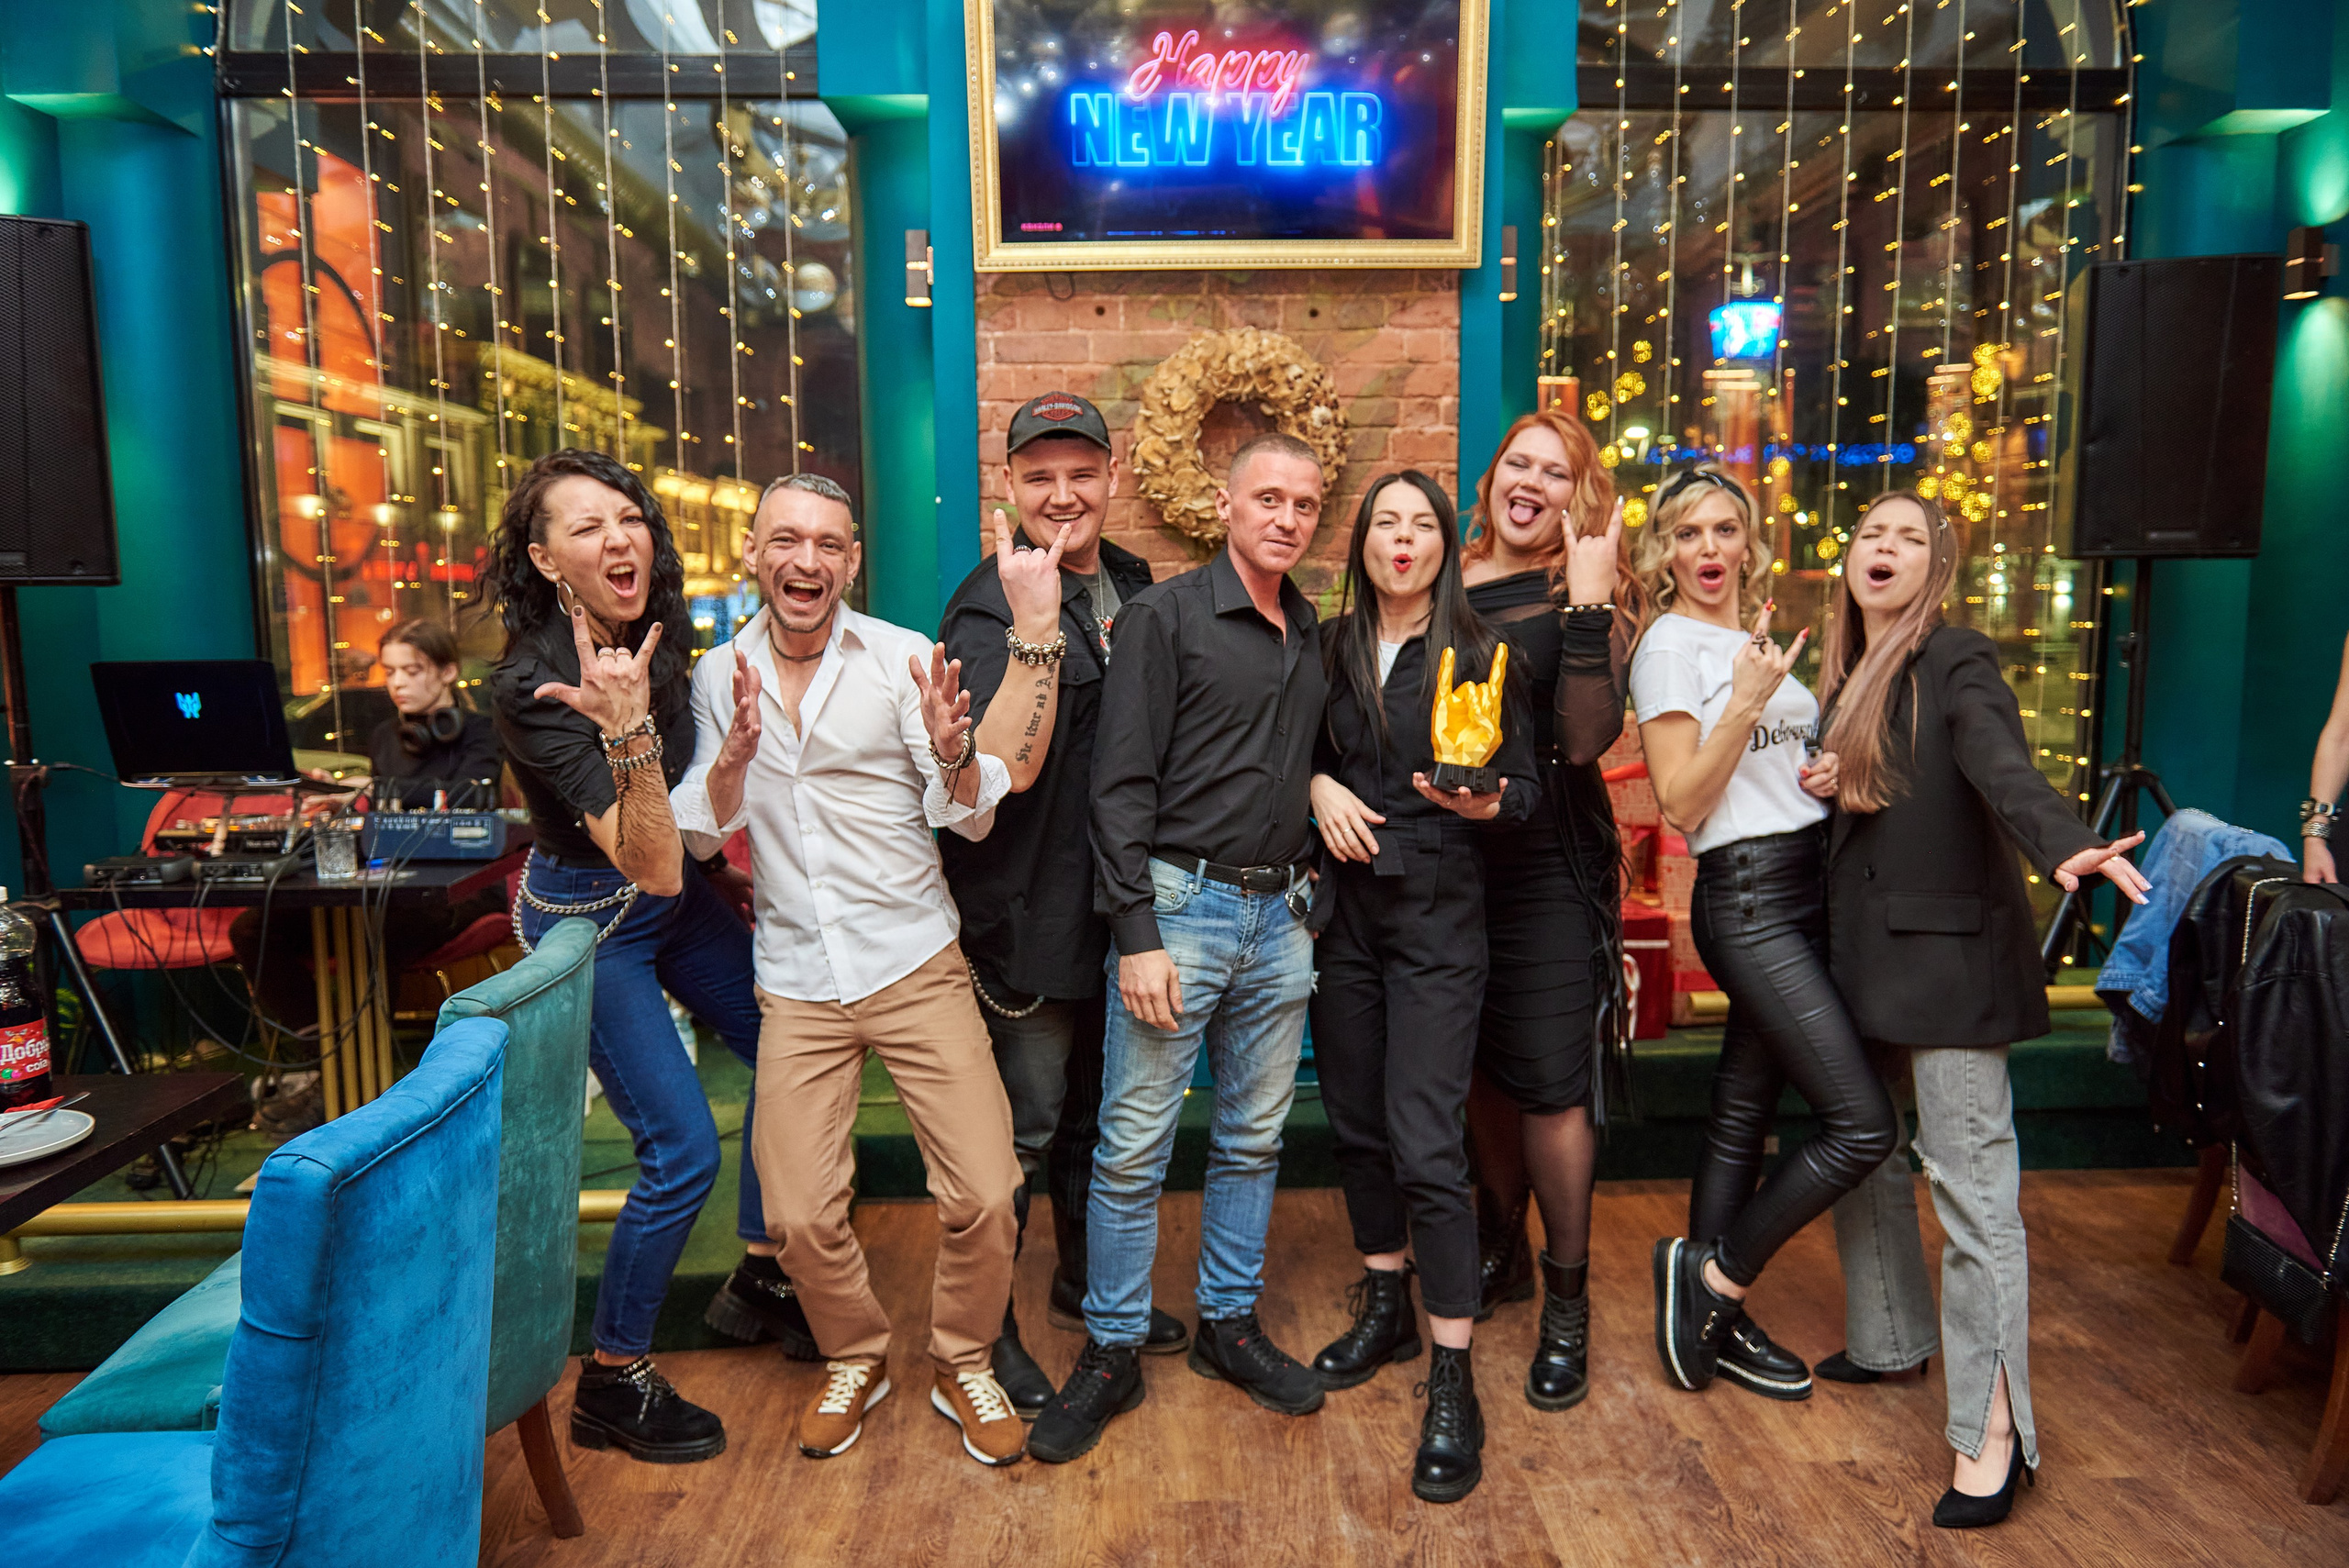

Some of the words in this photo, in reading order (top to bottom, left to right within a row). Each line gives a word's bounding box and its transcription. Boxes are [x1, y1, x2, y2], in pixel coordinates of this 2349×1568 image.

[1128, 29, 1310, 118] Happy
[1070, 92, 1216, 167] NEW
[1224, 92, 1383, 167] YEAR
